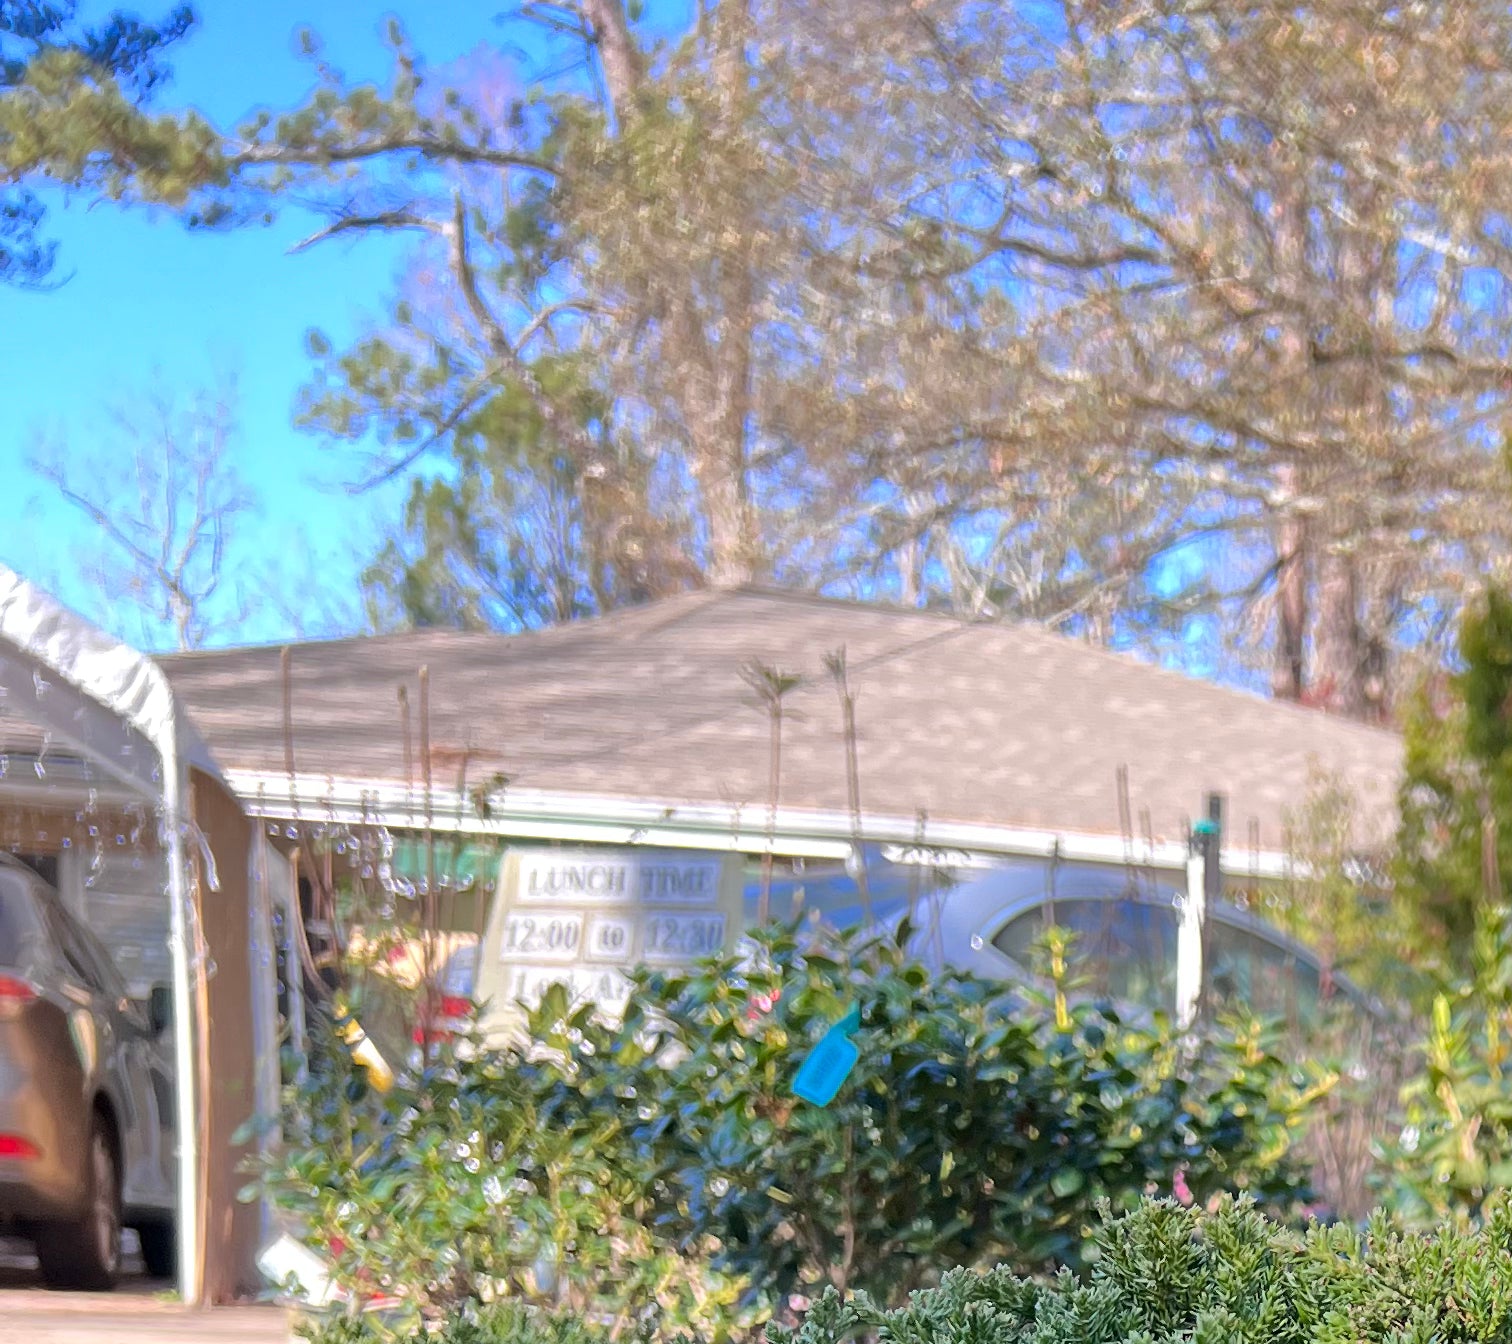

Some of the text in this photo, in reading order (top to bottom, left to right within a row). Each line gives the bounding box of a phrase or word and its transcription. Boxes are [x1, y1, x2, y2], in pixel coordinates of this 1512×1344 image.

[528, 865, 713, 897] LUNCH TIME
[506, 917, 724, 950] 12:00 to 12:30
